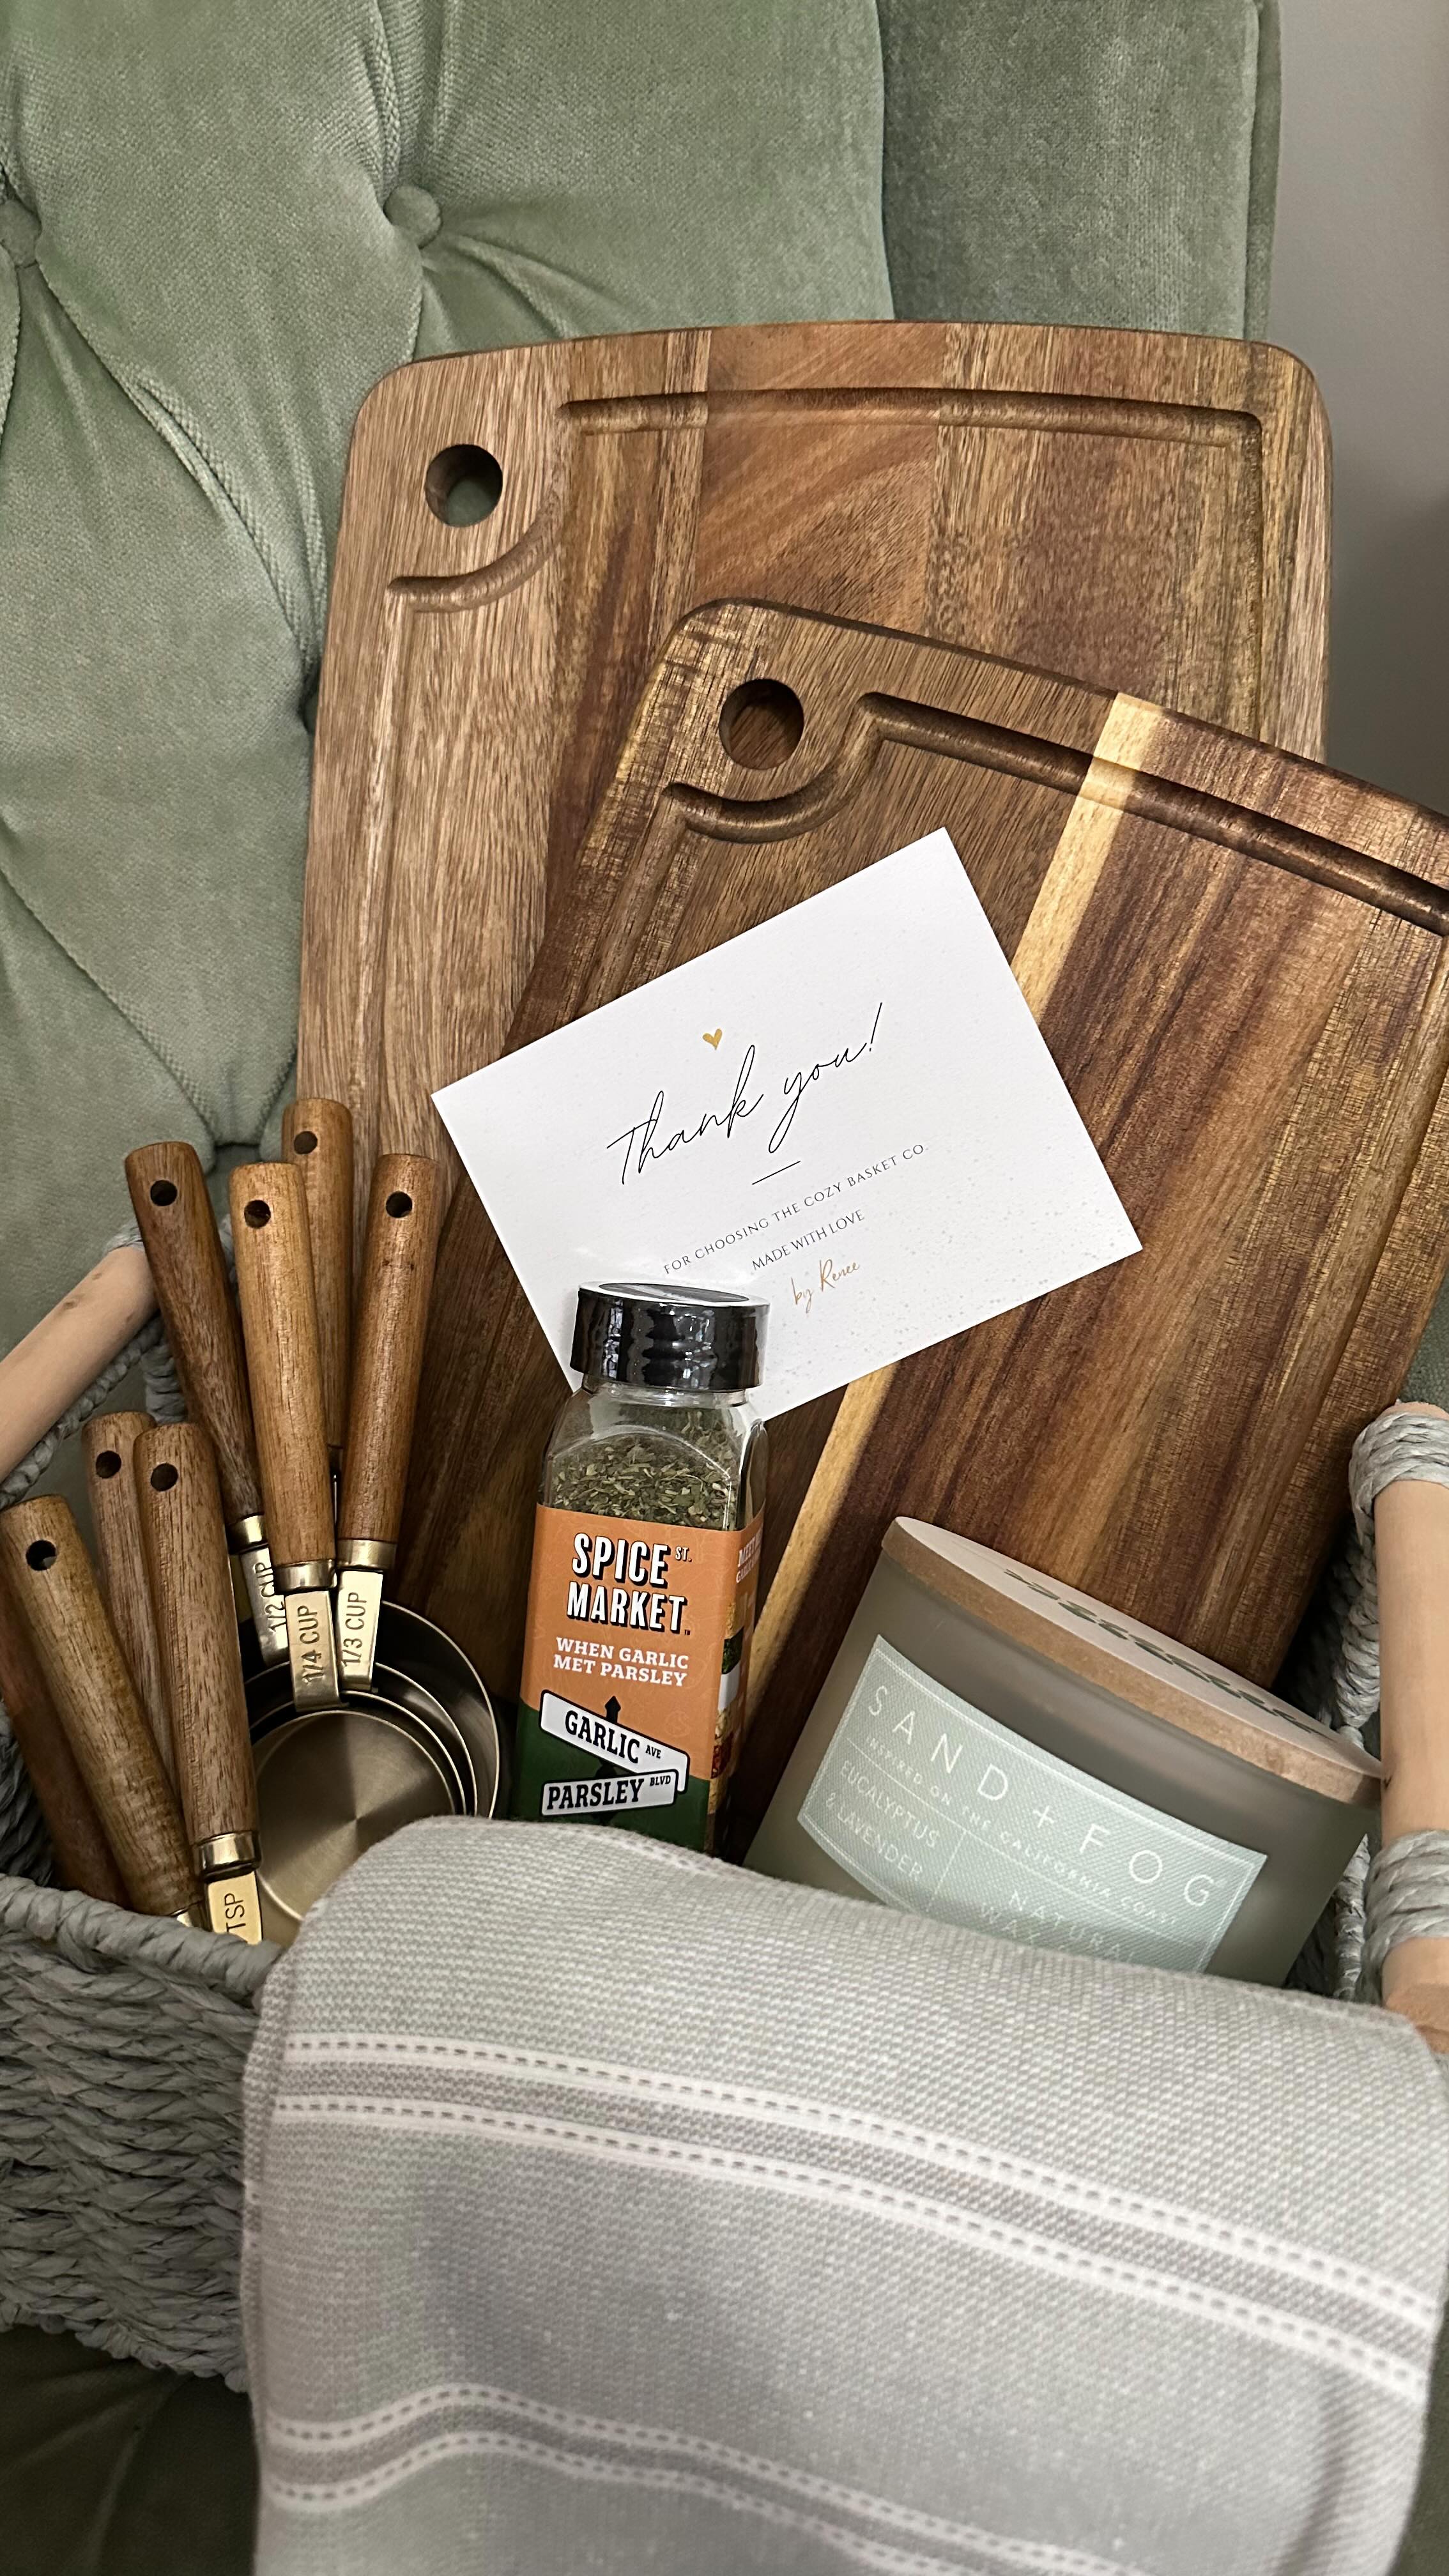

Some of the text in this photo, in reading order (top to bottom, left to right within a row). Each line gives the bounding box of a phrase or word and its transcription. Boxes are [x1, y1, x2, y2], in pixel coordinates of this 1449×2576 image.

[606, 1001, 883, 1186] Thank you!
[664, 1144, 924, 1275] FOR CHOOSING THE COZY BASKET CO
[751, 1209, 866, 1271] MADE WITH LOVE
[790, 1259, 861, 1314] by Renee
[571, 1532, 693, 1589] SPICE ST.
[264, 1601, 286, 1632] 1/2
[341, 1591, 367, 1667] 1/3 CUP
[567, 1581, 688, 1634] MARKET
[297, 1605, 325, 1684] 1/4 CUP
[553, 1654, 687, 1687] MET PARSLEY
[556, 1637, 689, 1669] WHEN GARLIC
[565, 1710, 662, 1764] GARLIC AVE
[547, 1775, 671, 1810] PARSLEY BLVD
[840, 1759, 942, 1848] EUCALYPTUS
[868, 1685, 1009, 1802] SAND
[1079, 1823, 1211, 1907] FOG
[837, 1805, 924, 1882] LAVENDER
[866, 1736, 923, 1784] INSPIRED
[962, 1805, 992, 1830] THE
[1000, 1830, 1112, 1898] CALIFORNIA
[1121, 1895, 1177, 1926] COAST
[224, 1892, 247, 1933] TSP
